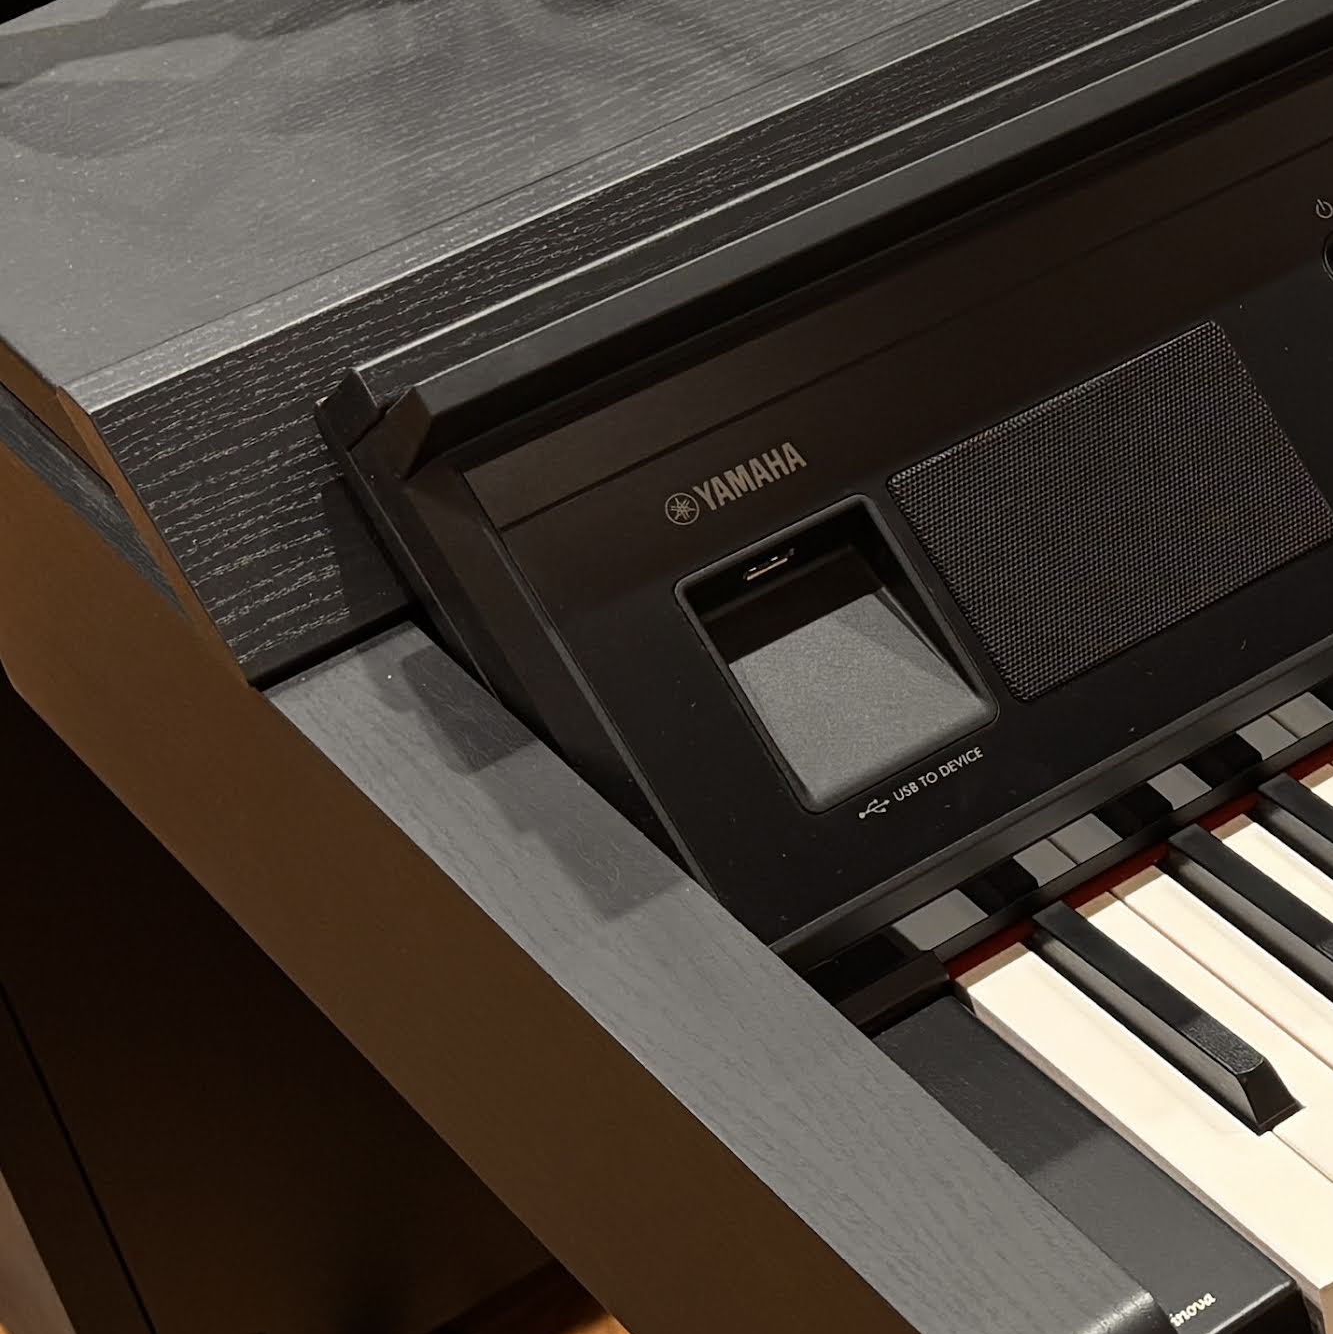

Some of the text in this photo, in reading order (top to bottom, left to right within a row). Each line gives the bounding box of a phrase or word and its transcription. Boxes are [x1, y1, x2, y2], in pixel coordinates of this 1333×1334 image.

[692, 441, 807, 512] YAMAHA
[893, 746, 985, 805] USB TO DEVICE
[1169, 1292, 1217, 1328] inova
